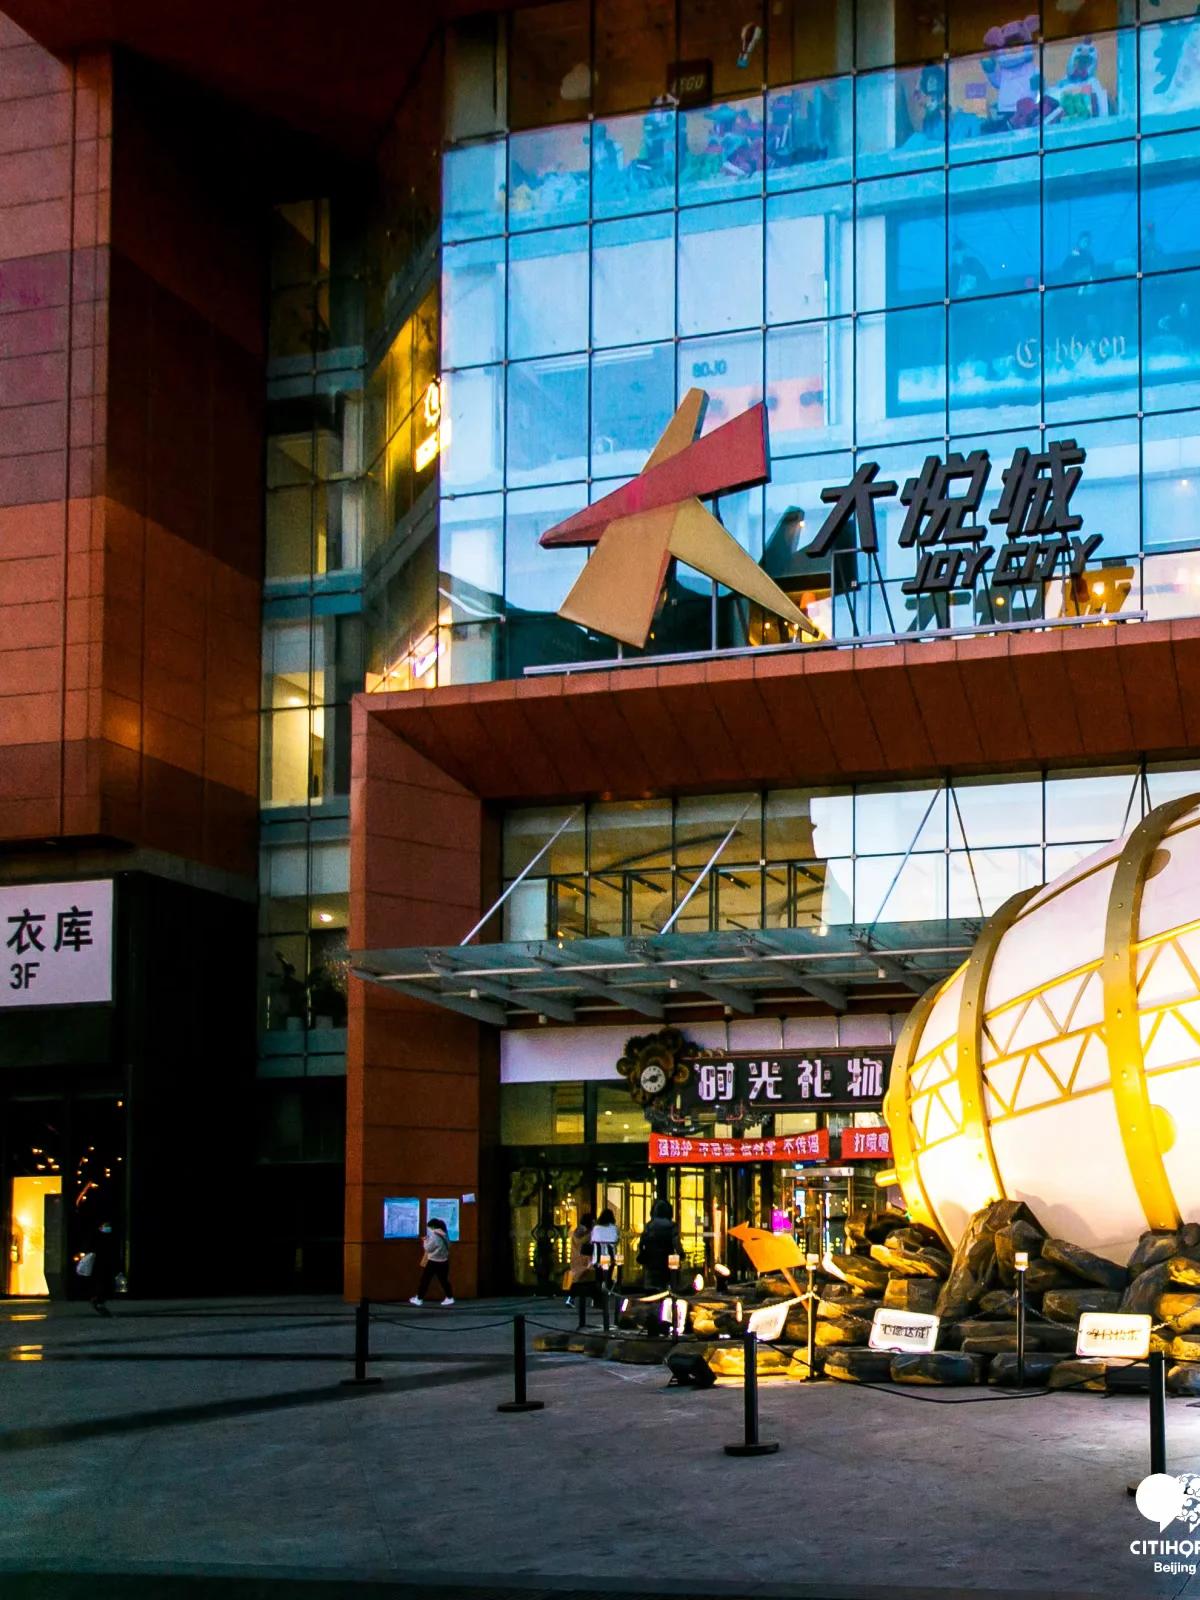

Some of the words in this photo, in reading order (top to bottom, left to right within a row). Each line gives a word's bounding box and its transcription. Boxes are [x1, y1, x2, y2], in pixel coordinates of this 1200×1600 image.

[805, 438, 1087, 558] 大悦城
[901, 545, 995, 594] JOY
[992, 533, 1104, 586] CITY
[6, 904, 94, 955] 衣库
[10, 962, 40, 990] 3F
[693, 1057, 884, 1101] 时光礼物
